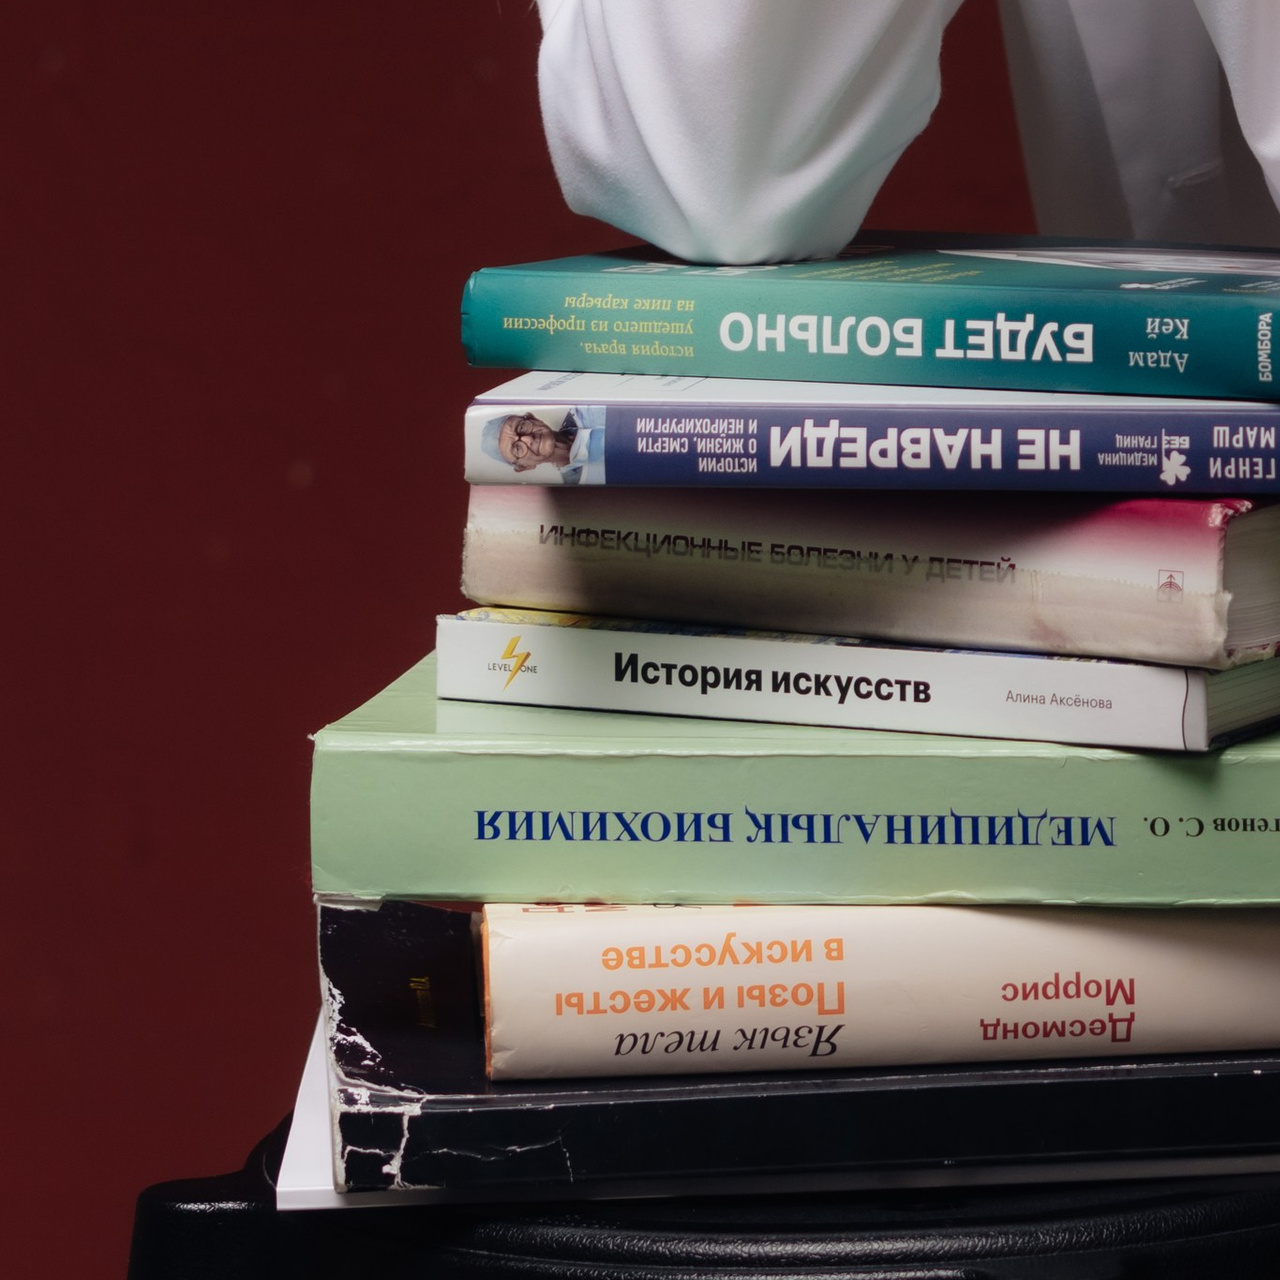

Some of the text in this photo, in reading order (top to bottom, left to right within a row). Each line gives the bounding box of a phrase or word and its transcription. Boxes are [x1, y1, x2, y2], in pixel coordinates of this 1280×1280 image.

[564, 295, 695, 312] на пике карьеры
[503, 315, 694, 335] ушедшего из профессии
[1146, 317, 1189, 339] Кей
[719, 311, 1094, 363] БУДЕТ БОЛЬНО
[1258, 311, 1272, 382] БОМБОРА
[632, 343, 694, 358] история
[1128, 350, 1189, 372] Адам
[637, 417, 758, 436] И НЕЙРОХИРУРГИИ
[1212, 426, 1276, 448] МАРШ
[637, 436, 757, 453] О ЖИЗНИ, СМЕРТИ
[768, 419, 1081, 470] НЕ НАВРЕДИ
[1115, 433, 1190, 449] БЕЗ ГРАНИЦ
[699, 456, 758, 473] ИСТОРИИ
[1098, 451, 1157, 467] МЕДИЦИНА
[1209, 456, 1276, 479] ГЕНРИ
[538, 523, 1017, 584] ИНФЕКЦИОННЫЕ БОЛЕЗНИ У ДЕТЕЙ
[488, 663, 537, 673] LEVEL ONE
[613, 651, 933, 705] История искусств
[1006, 690, 1113, 709] Алина Аксёнова
[474, 804, 1117, 848] МЕДИЦИНАЛЫҚ БИОХИМИЯ
[1143, 816, 1170, 837] О.
[1179, 817, 1205, 837] С.
[601, 931, 845, 972] в искусстве
[554, 981, 846, 1017] Позы и жесты
[1000, 971, 1136, 1006] Моррис
[979, 1012, 1136, 1045] Десмонд
[614, 1023, 845, 1058] Язык тела
